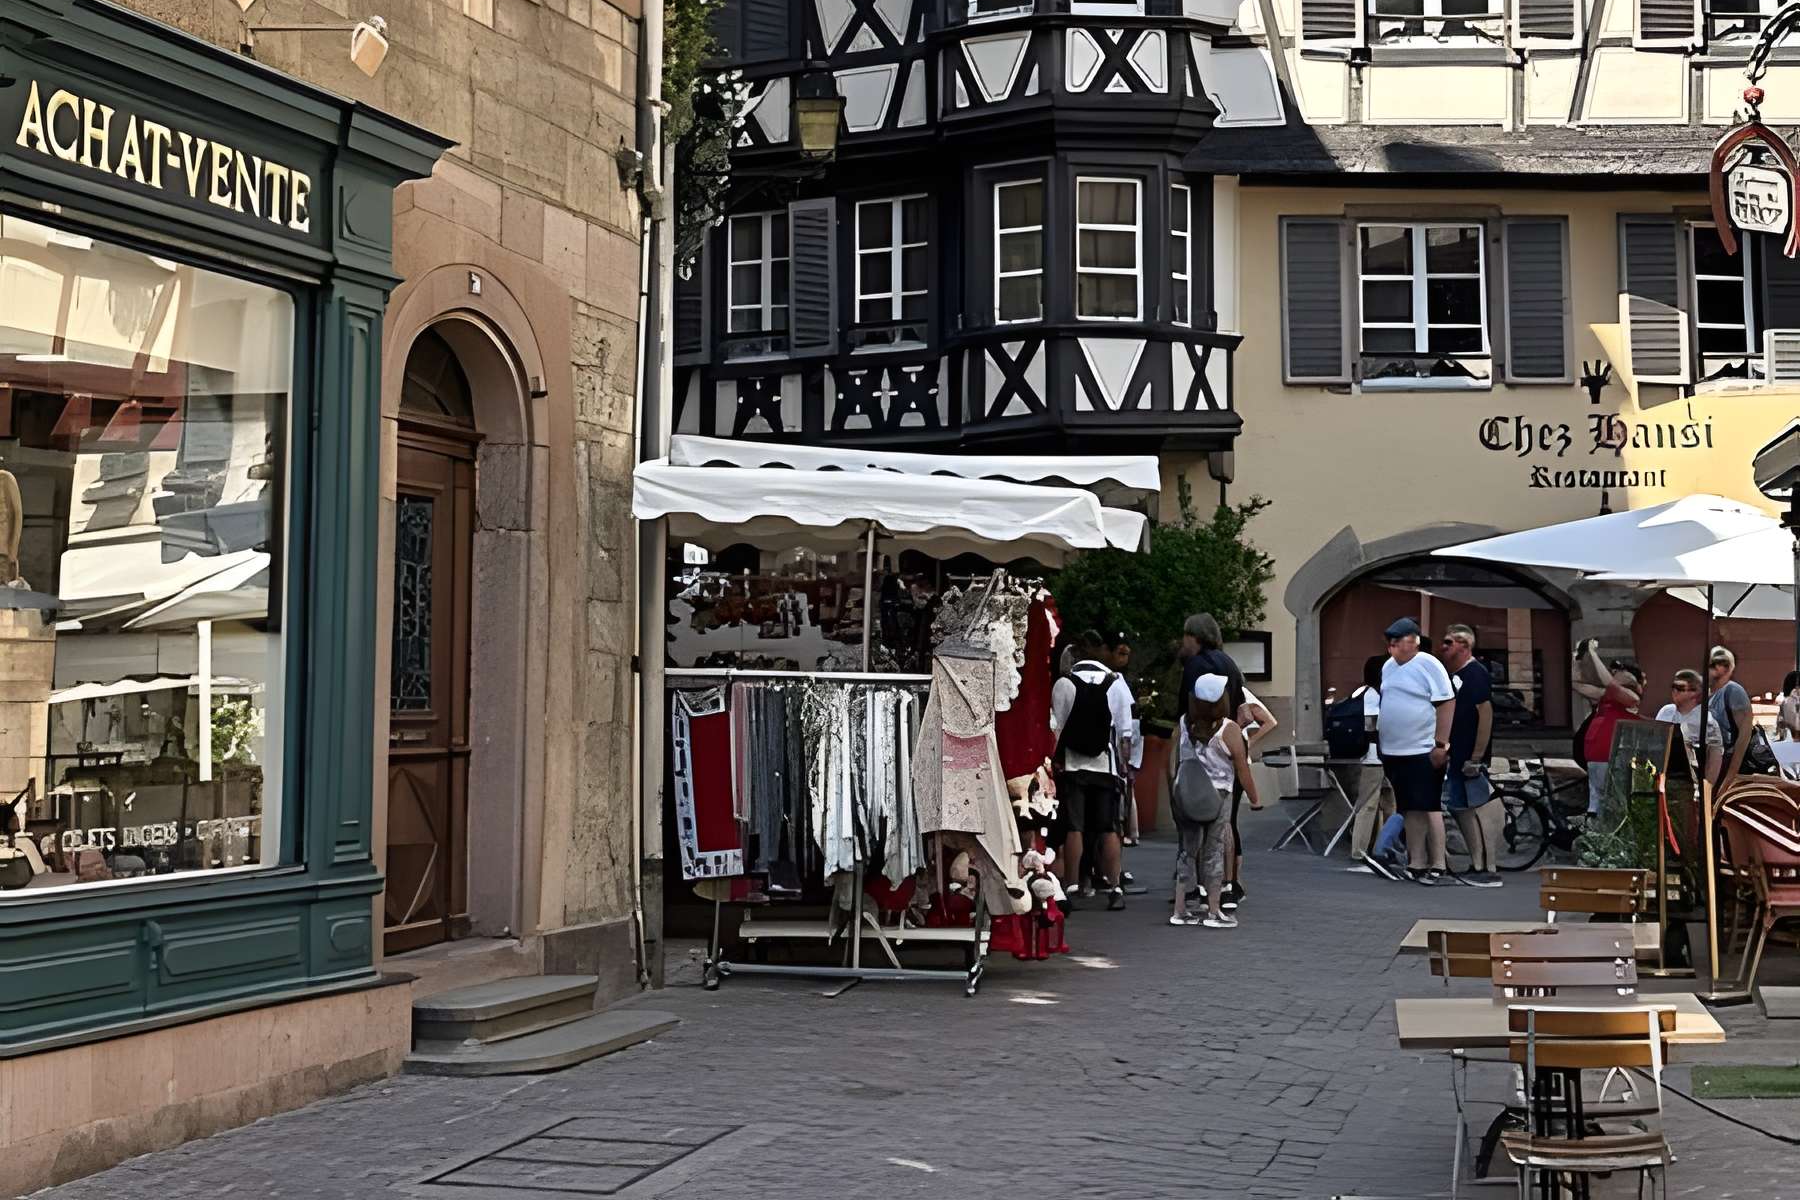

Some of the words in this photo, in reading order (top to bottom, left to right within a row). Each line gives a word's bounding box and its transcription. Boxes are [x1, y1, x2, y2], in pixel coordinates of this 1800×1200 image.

[16, 79, 311, 233] ACHAT-VENTE
[1478, 415, 1572, 458] Chez
[1588, 412, 1714, 458] Hansi
